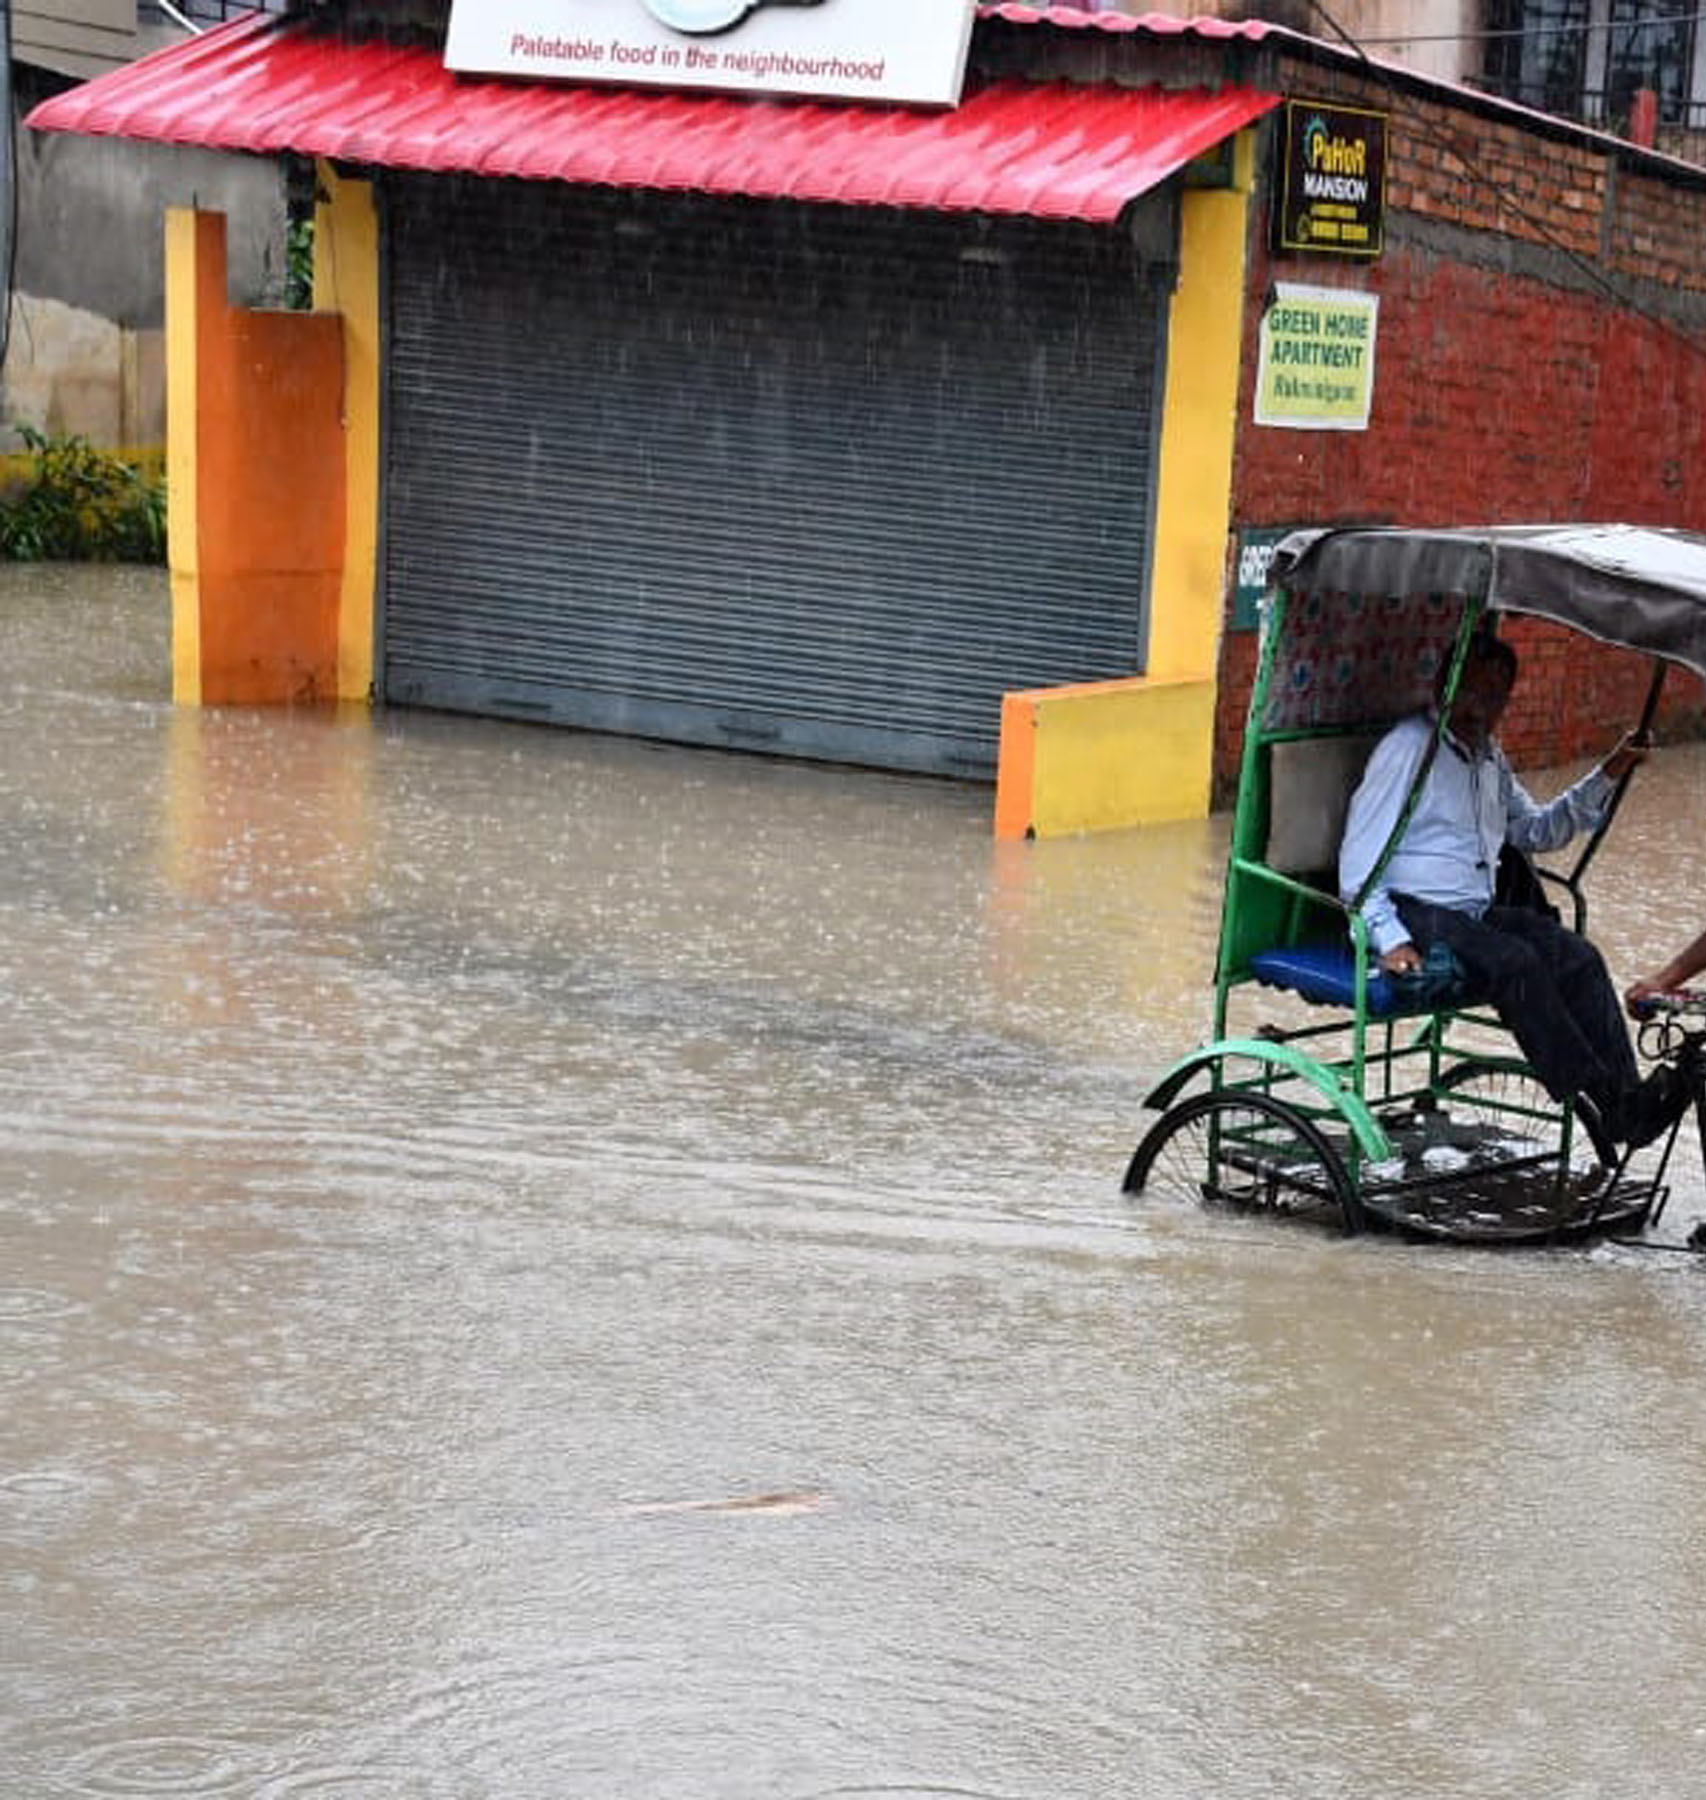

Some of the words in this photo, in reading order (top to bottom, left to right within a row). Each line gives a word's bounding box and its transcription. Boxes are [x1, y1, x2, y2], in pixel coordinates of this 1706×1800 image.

[510, 34, 604, 61] Palatable
[610, 41, 658, 66] food
[662, 45, 681, 67] in
[685, 46, 718, 69] the
[723, 50, 885, 81] neighbourhood
[1303, 172, 1368, 201] MANSION
[1269, 308, 1320, 336] GREEN
[1324, 312, 1369, 339] HOME
[1270, 340, 1363, 369] APARTMENT
